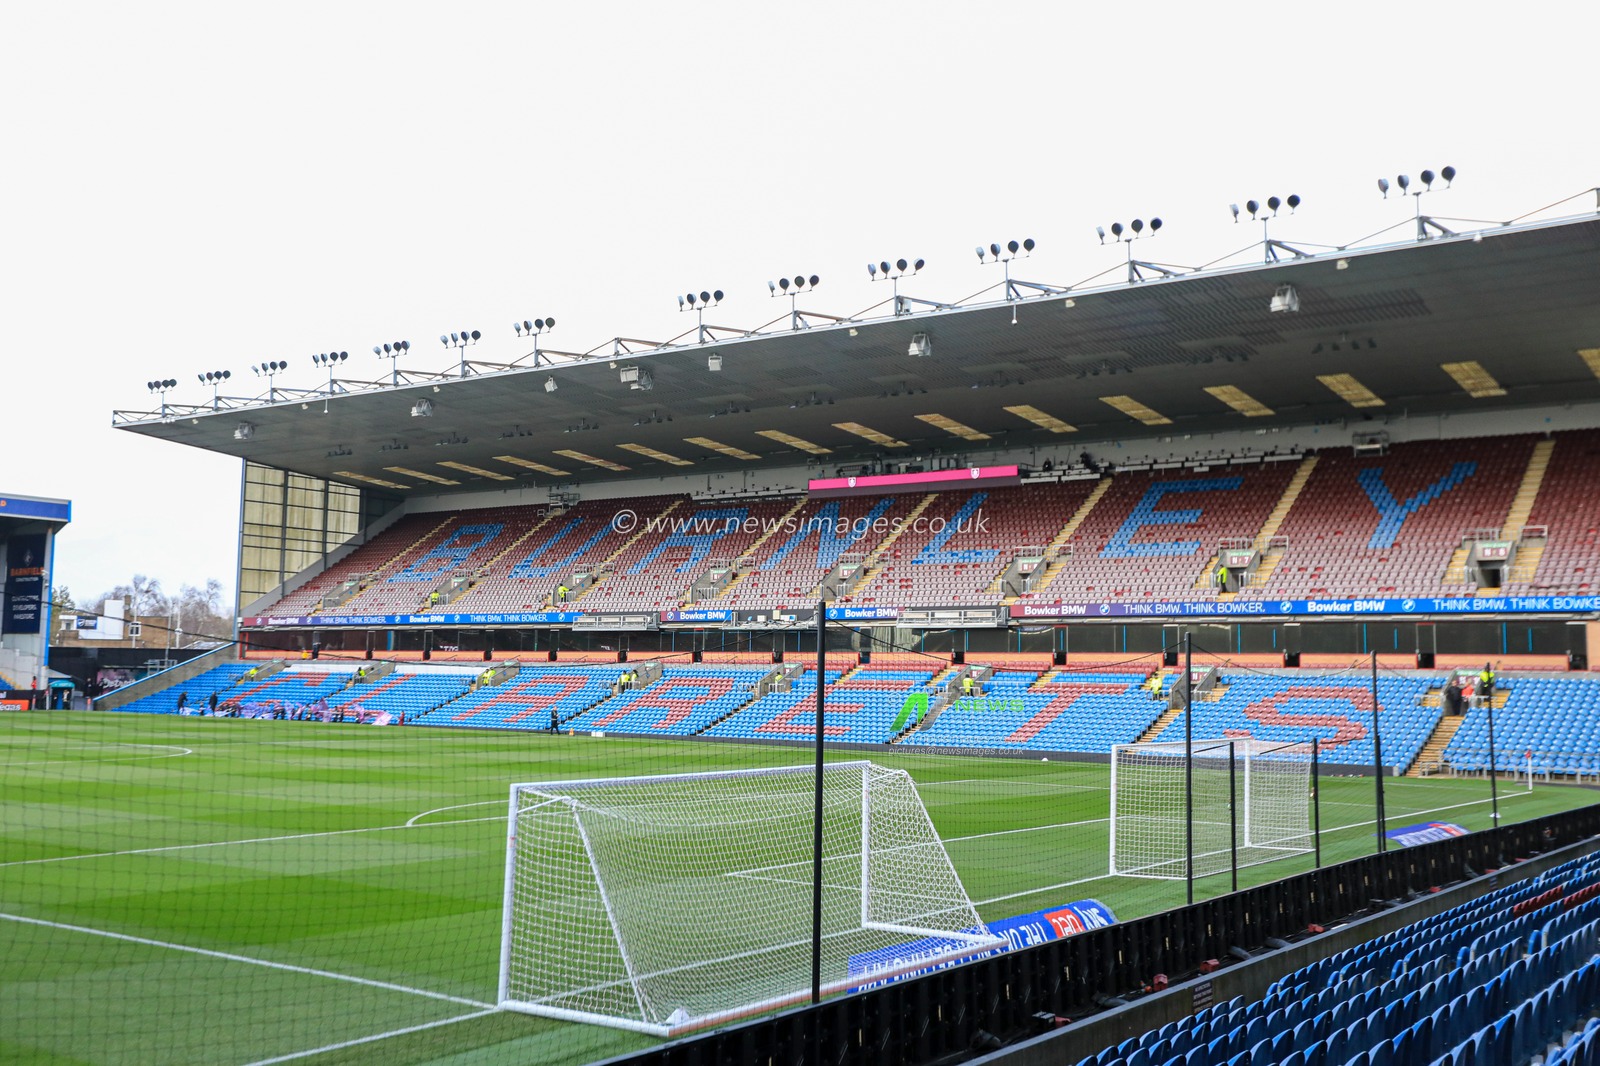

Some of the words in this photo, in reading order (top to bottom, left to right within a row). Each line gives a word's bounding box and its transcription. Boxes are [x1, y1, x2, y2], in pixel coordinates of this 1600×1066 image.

[1124, 604, 1153, 614] THINK
[1157, 604, 1182, 614] BMW.
[1184, 602, 1216, 614] THINK
[1218, 602, 1266, 613] BOWKER.
[1308, 600, 1352, 612] Bowker
[1353, 600, 1385, 612] BMW
[1433, 599, 1470, 611] THINK
[1473, 598, 1507, 610] BMW.
[1510, 598, 1551, 610] THINK
[680, 611, 706, 620] Bowker
[708, 610, 726, 620] BMW
[845, 610, 874, 618] Bowker
[876, 609, 898, 618] BMW
[1024, 606, 1060, 616] Bowker
[1062, 605, 1086, 614] BMW
[348, 616, 362, 624] THINK
[408, 614, 430, 624] Bowker
[430, 614, 446, 623] BMW
[470, 615, 486, 623] THINK
[504, 614, 520, 622] THINK
